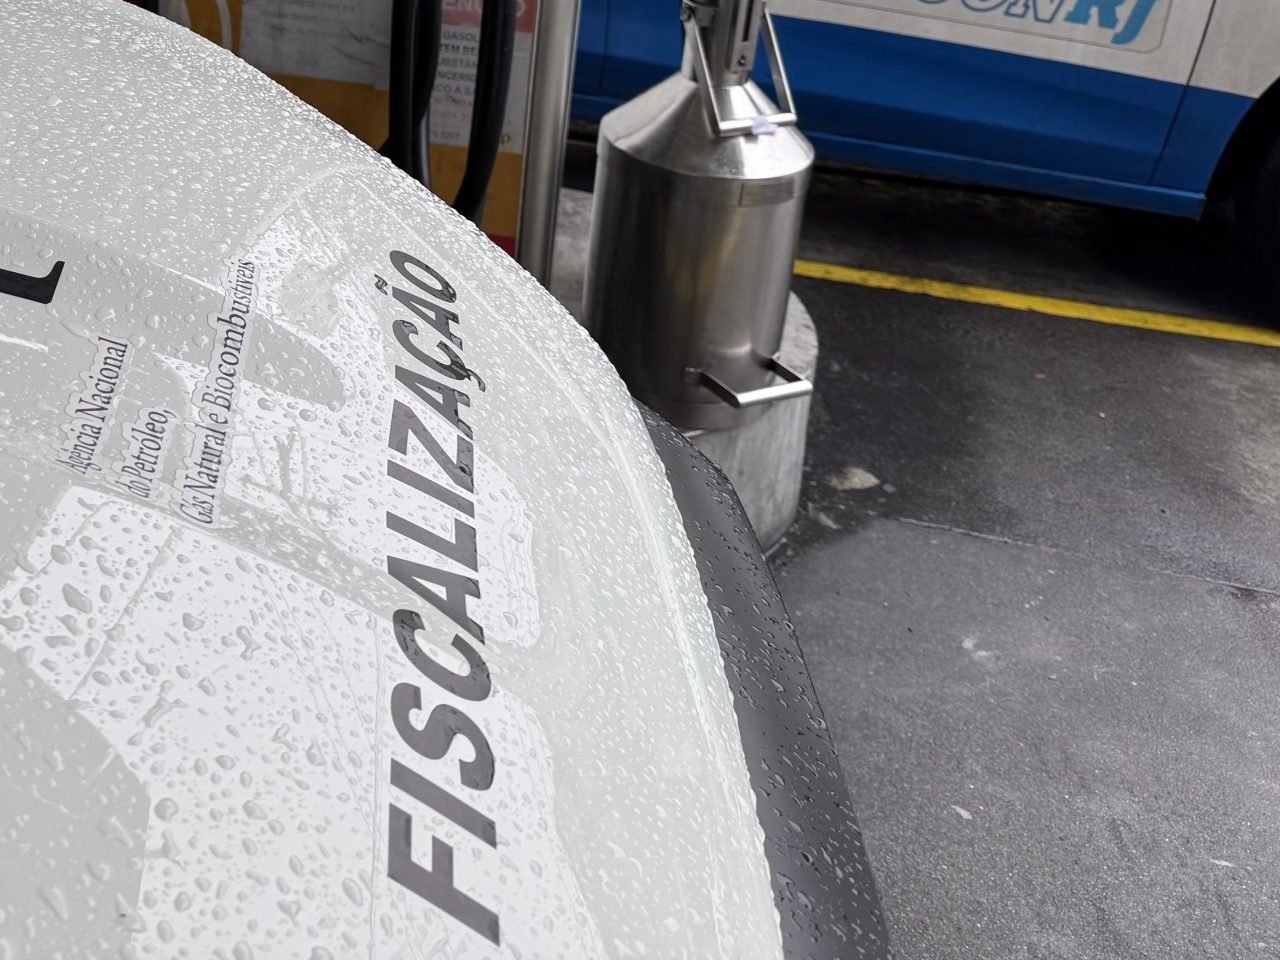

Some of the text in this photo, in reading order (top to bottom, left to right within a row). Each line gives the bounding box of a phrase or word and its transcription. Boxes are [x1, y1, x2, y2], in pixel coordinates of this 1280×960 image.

[55, 336, 128, 475] Agência Nacional
[114, 408, 177, 499] do Petróleo,
[179, 258, 256, 524] Gás Natural e Biocombustíveis
[373, 249, 501, 947] FISCALIZAÇÃO
